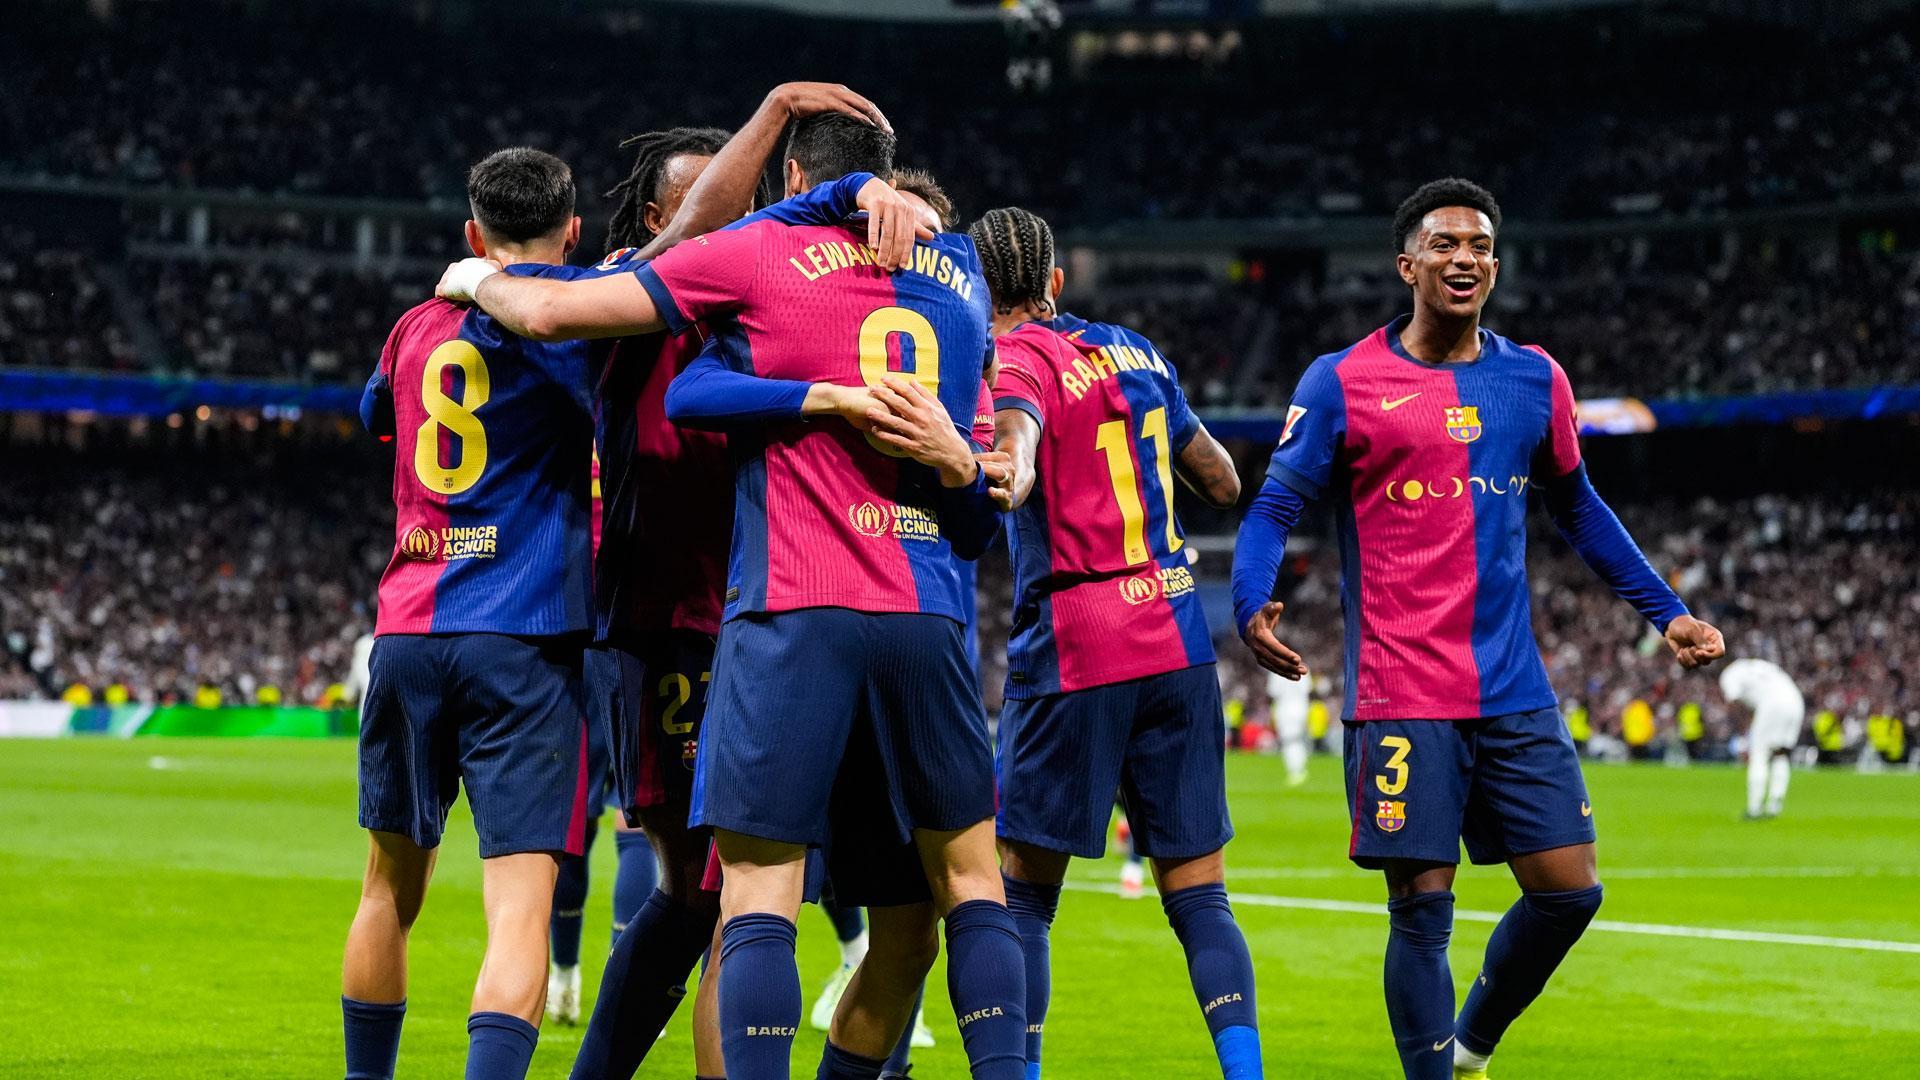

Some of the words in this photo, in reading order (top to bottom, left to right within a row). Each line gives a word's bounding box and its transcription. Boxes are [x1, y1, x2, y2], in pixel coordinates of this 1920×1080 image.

[789, 240, 972, 301] LEWANWSKI
[414, 339, 490, 494] 8
[1096, 407, 1184, 566] 11
[890, 505, 938, 523] UNHCR
[441, 525, 497, 541] UNHCR
[892, 518, 939, 537] ACNUR
[442, 539, 497, 555] ACNUR
[1376, 735, 1412, 796] 3
[747, 1026, 796, 1037] BARÇA
